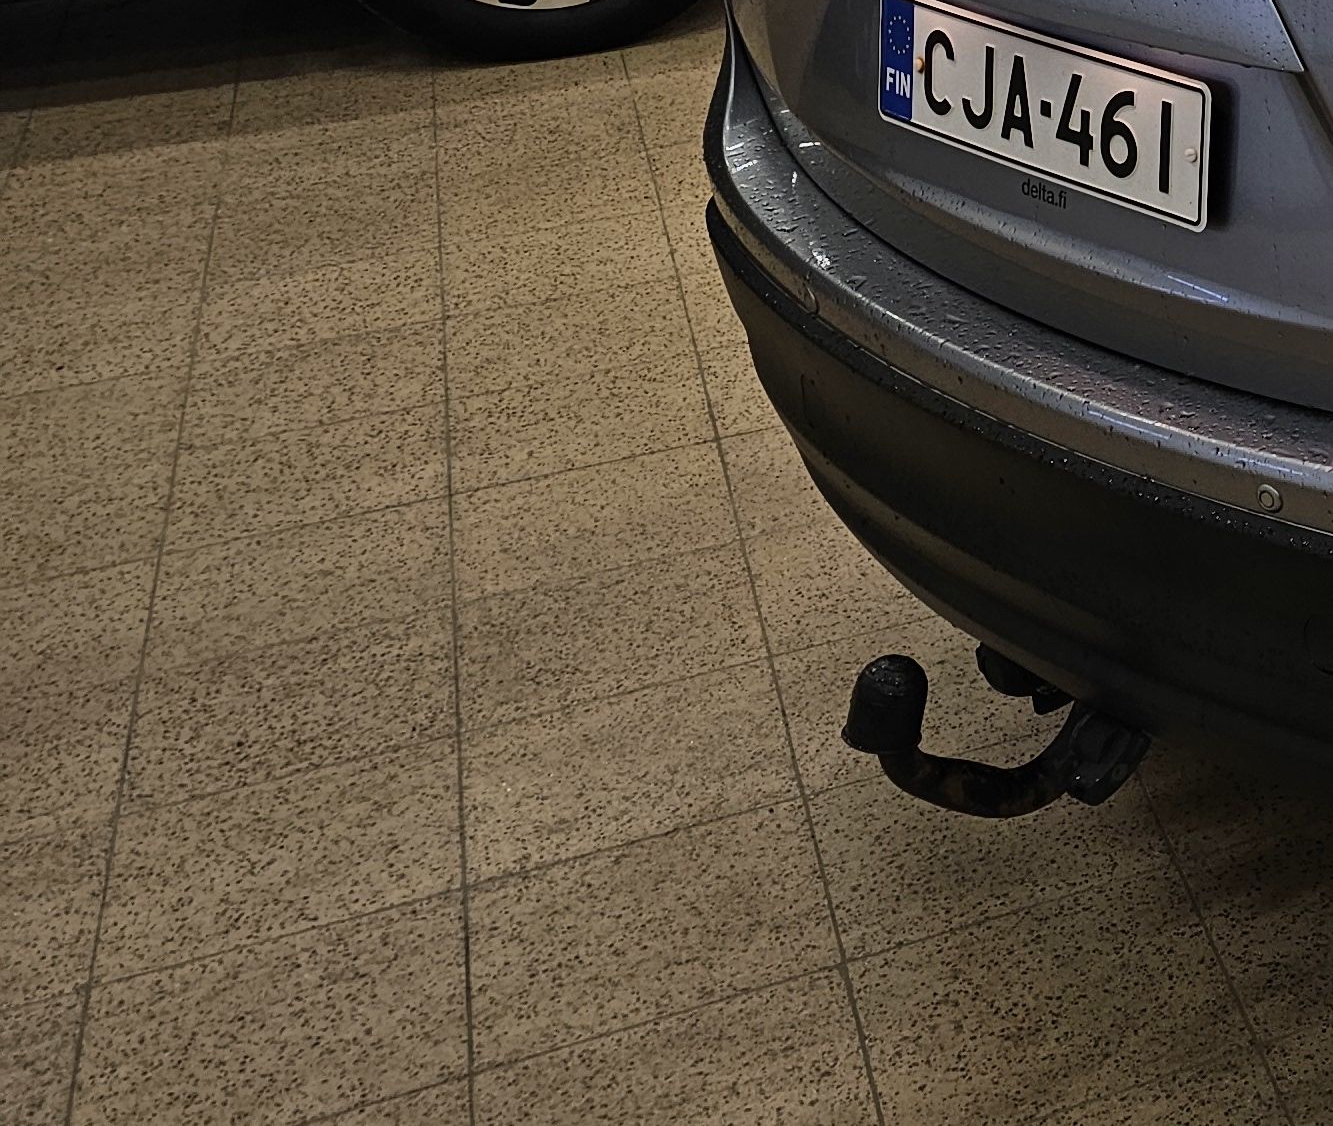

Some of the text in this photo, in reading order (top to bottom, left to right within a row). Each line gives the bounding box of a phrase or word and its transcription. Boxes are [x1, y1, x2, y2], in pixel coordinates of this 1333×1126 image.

[886, 66, 911, 99] FIN
[923, 29, 1173, 195] CJA-461
[1021, 177, 1068, 210] delta.fi
